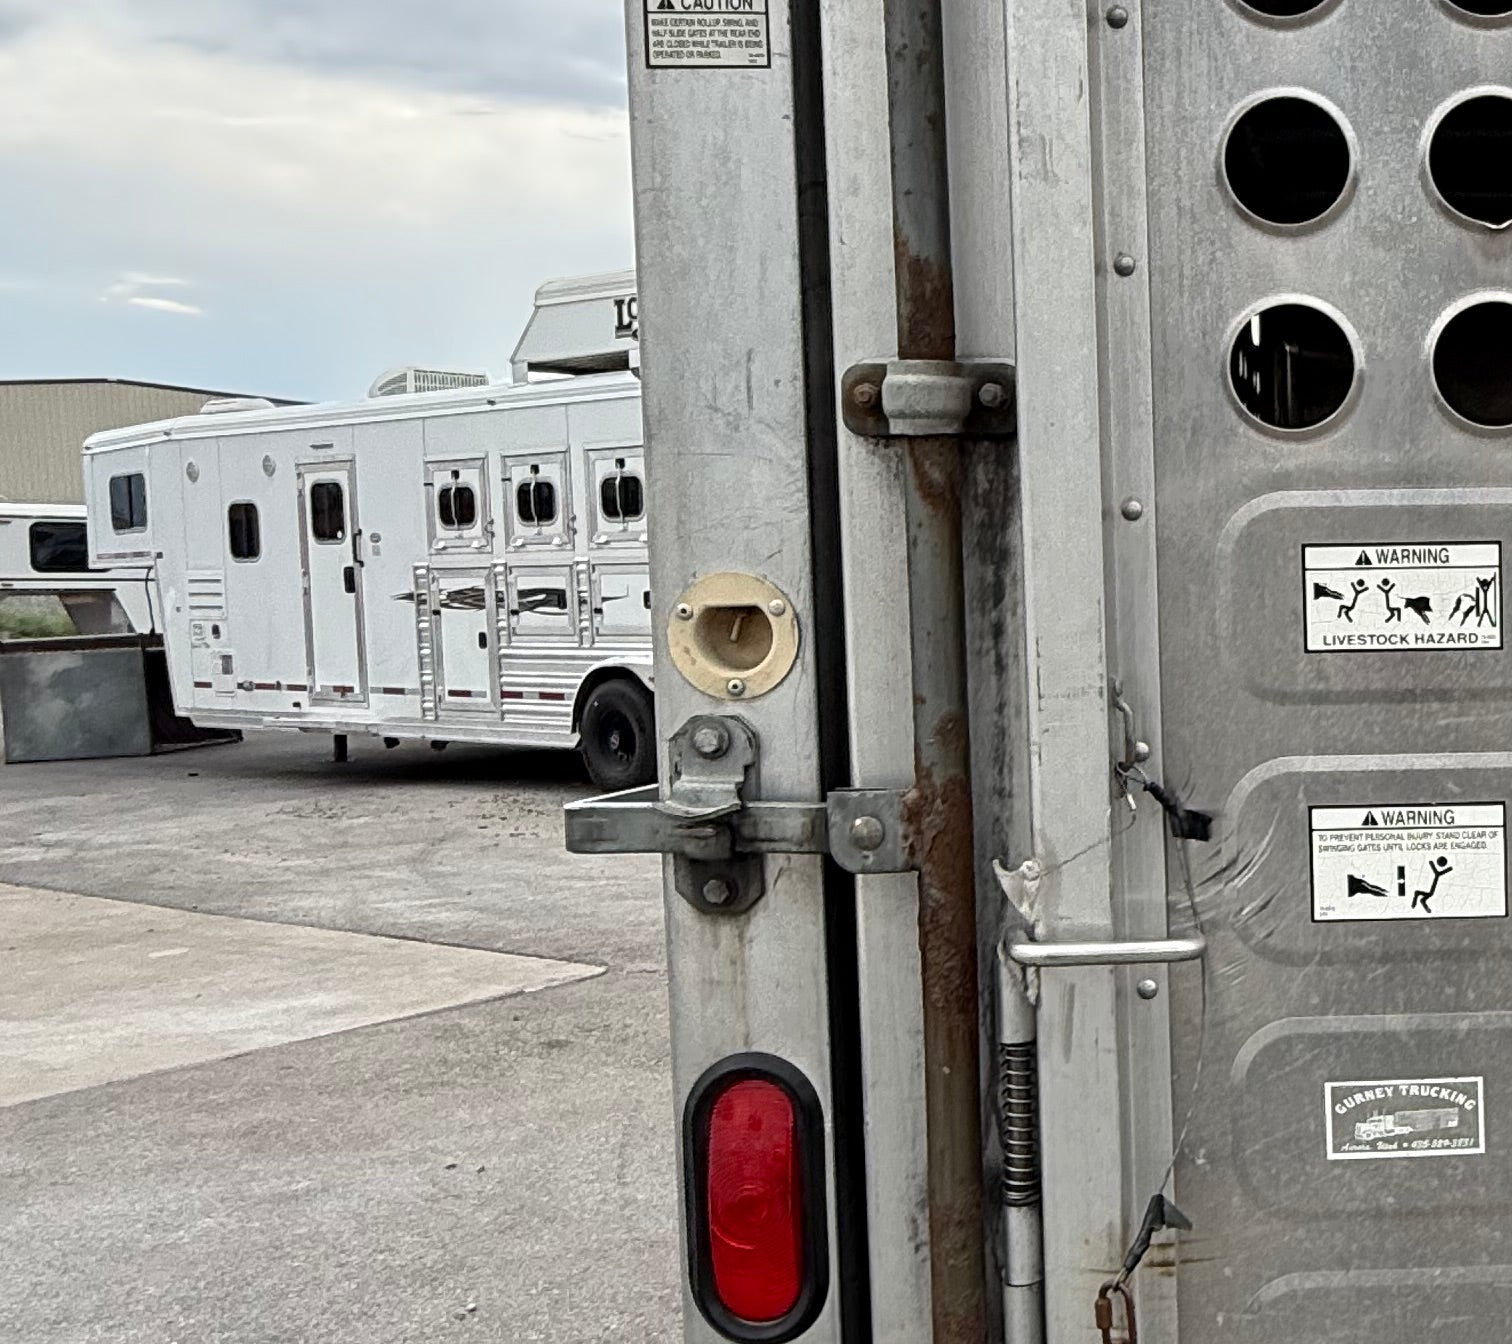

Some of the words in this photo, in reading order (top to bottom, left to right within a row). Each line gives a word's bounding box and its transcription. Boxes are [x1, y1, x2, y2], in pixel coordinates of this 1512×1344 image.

[1376, 548, 1450, 564] WARNING
[1322, 633, 1410, 647] LIVESTOCK
[1414, 632, 1479, 645] HAZARD
[1381, 809, 1455, 826] WARNING
[1318, 834, 1328, 842] TO
[1329, 833, 1363, 842] PREVENT
[1365, 832, 1405, 841] PERSONAL
[1436, 831, 1460, 840] STAND
[1462, 831, 1486, 840] CLEAR
[1487, 830, 1499, 839] OF
[1357, 843, 1381, 852] GATES
[1383, 843, 1403, 852] UNTIL
[1406, 842, 1431, 852] LOCKS
[1433, 842, 1449, 851] ARE
[1334, 1086, 1395, 1114] GURNEY
[1398, 1085, 1477, 1111] TRUCKING
